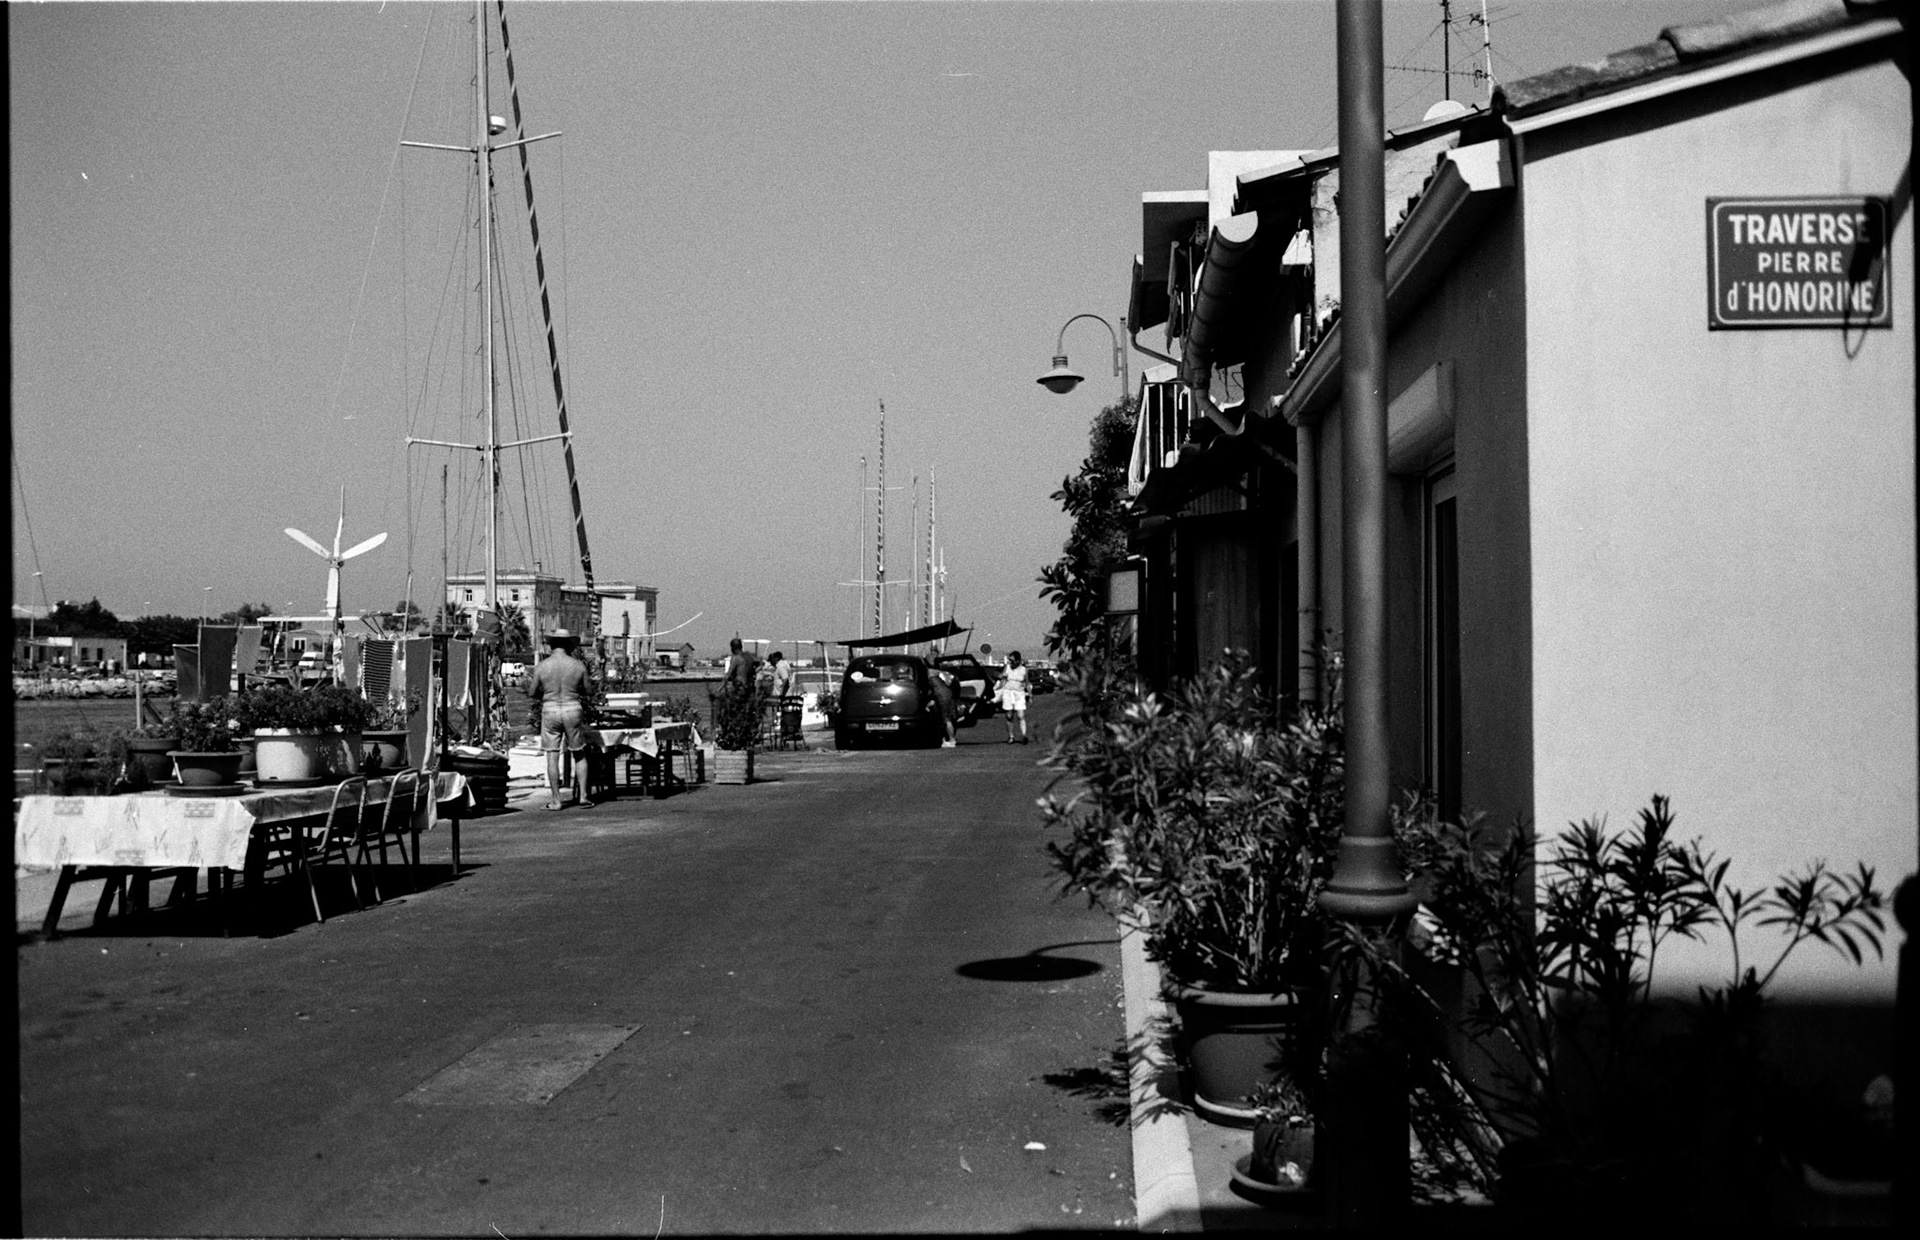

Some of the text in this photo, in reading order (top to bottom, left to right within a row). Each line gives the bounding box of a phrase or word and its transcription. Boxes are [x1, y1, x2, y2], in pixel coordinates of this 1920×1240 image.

[1728, 213, 1871, 245] TRAVERSE
[1758, 251, 1844, 274] PIERRE
[1727, 280, 1874, 313] d'HONORINE
